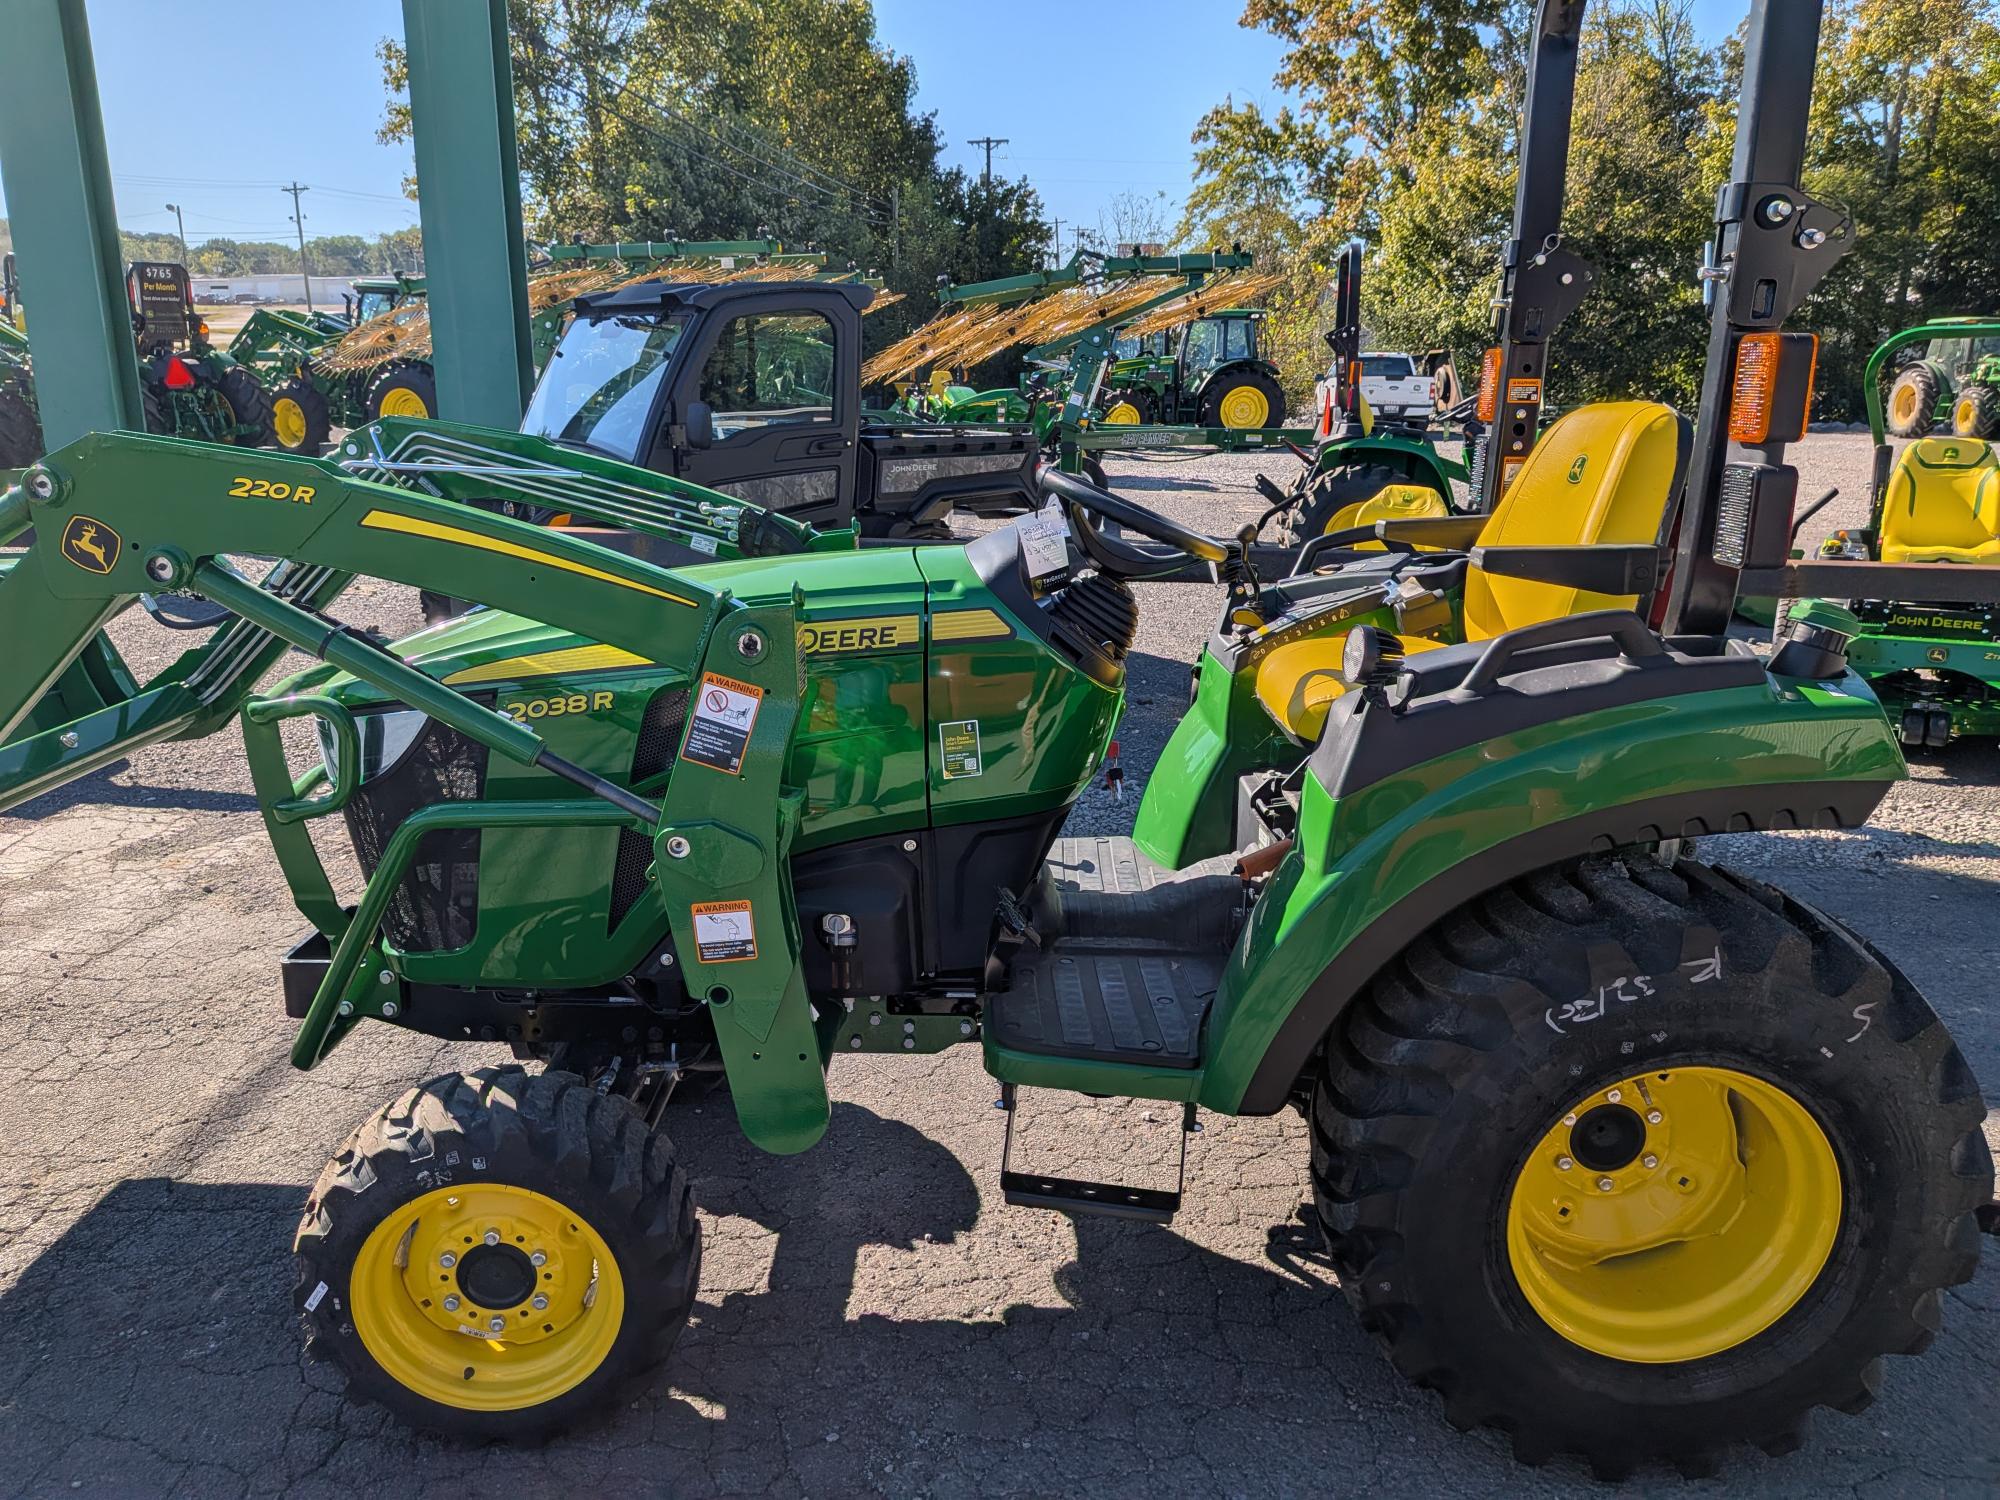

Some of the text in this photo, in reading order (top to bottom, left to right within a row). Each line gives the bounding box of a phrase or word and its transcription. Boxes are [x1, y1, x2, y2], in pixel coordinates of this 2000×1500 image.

[146, 268, 172, 278] $765
[143, 283, 177, 292] Per Month
[229, 477, 316, 504] 220 R
[1888, 614, 1984, 629] JOHN DEERE
[804, 626, 897, 651] DEERE
[716, 676, 760, 697] WARNING
[507, 692, 614, 722] 2038 R
[704, 902, 748, 912] WARNING
